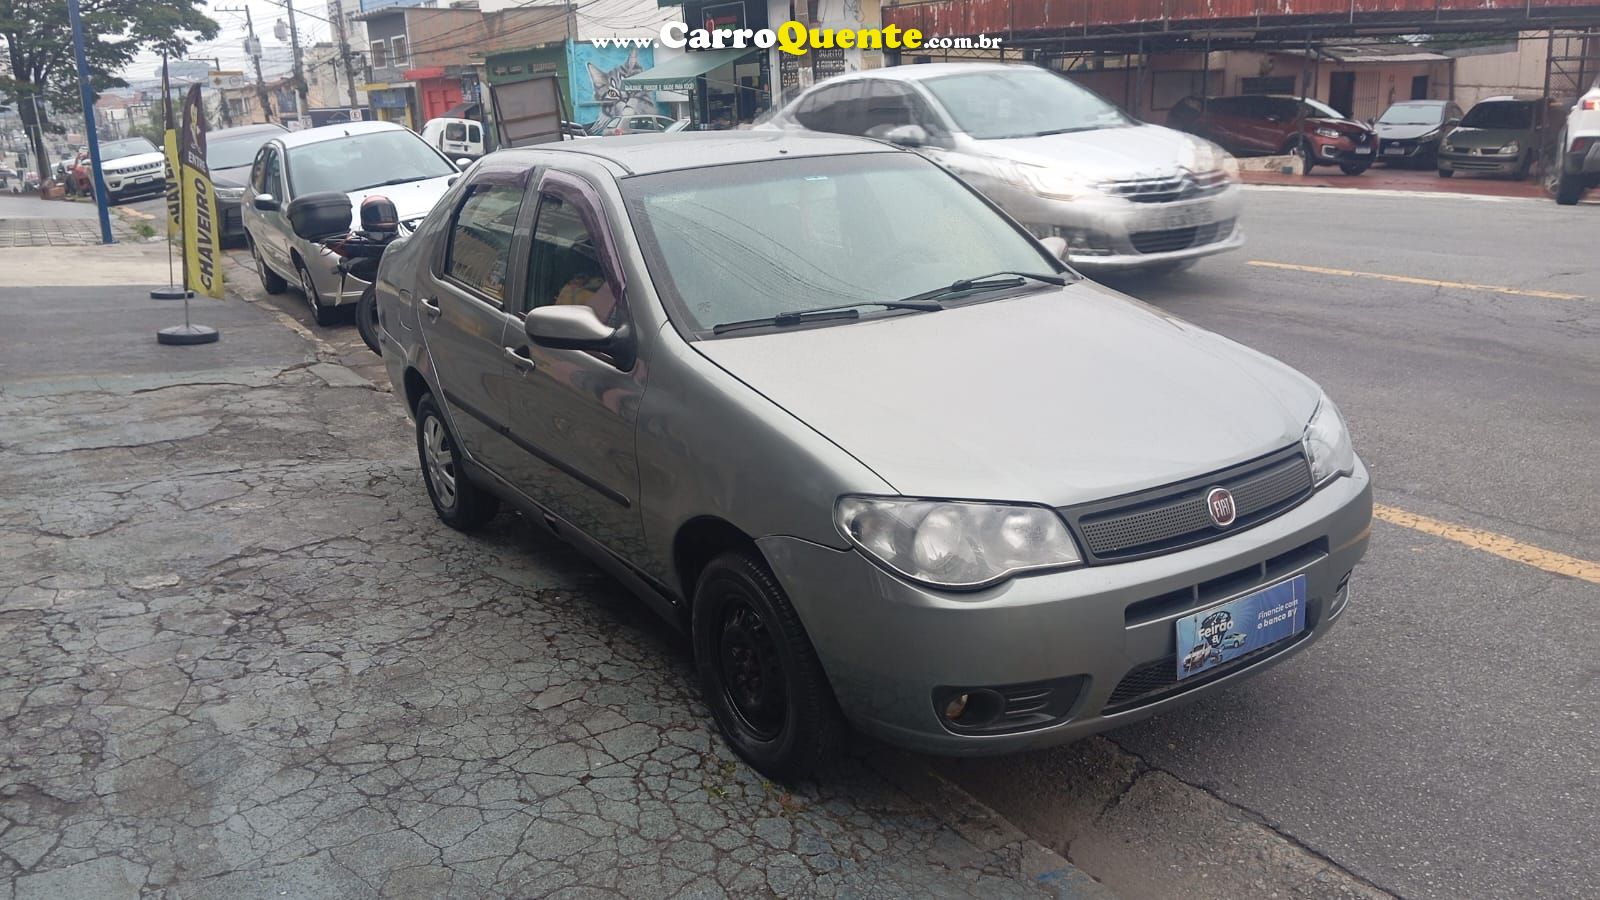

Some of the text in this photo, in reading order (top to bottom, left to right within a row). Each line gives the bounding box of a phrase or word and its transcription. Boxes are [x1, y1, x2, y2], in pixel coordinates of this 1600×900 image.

[194, 177, 214, 291] CHAVEIRO
[1213, 497, 1231, 518] FIAT
[1257, 599, 1299, 620] Financie com
[1198, 618, 1234, 639] Feirão
[1257, 622, 1264, 630] o
[1263, 613, 1287, 628] banco
